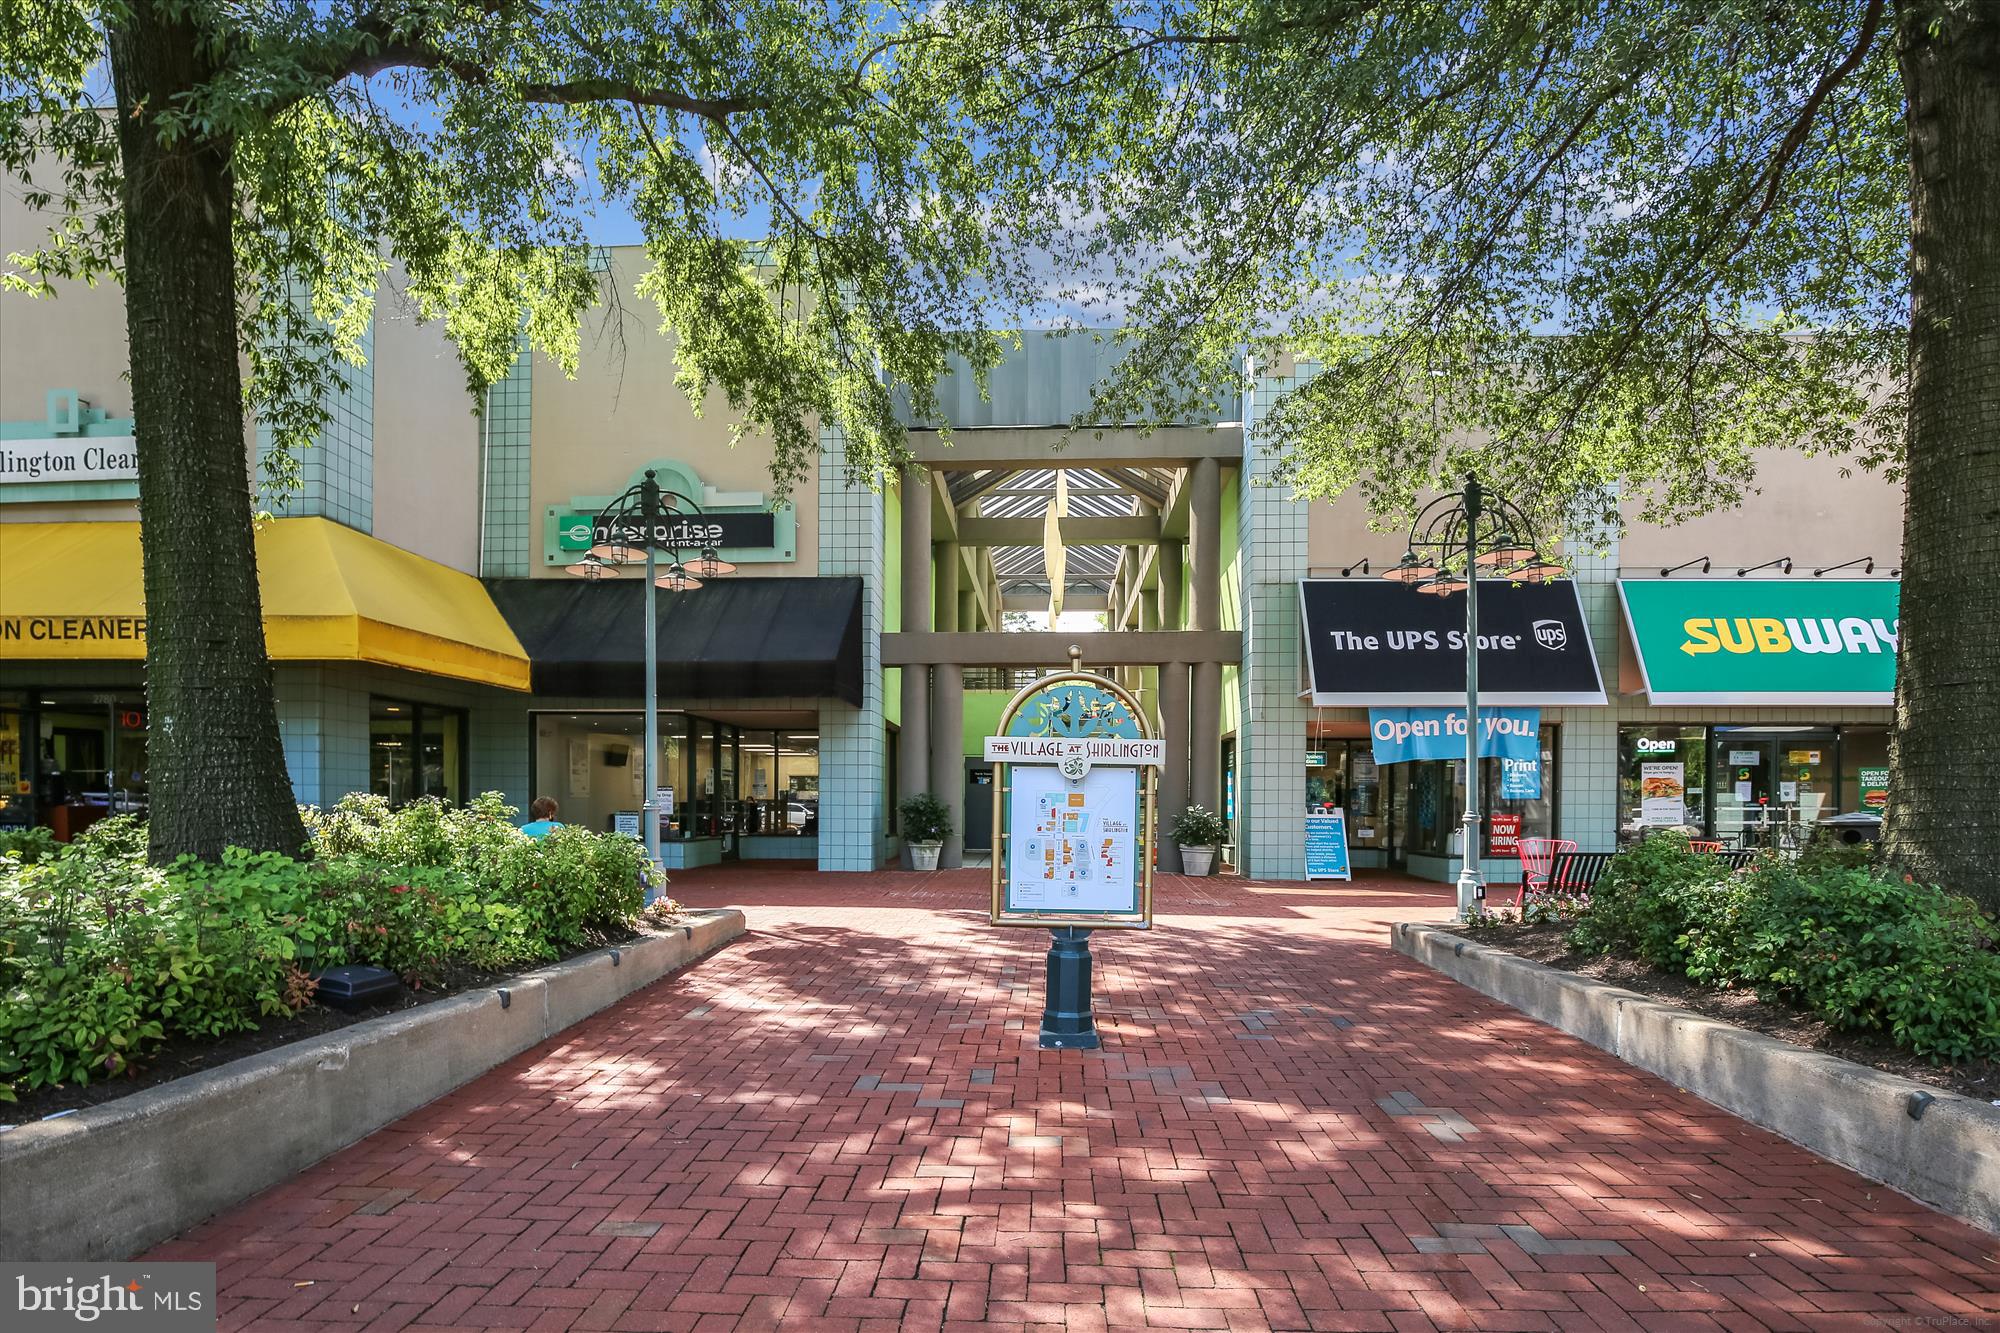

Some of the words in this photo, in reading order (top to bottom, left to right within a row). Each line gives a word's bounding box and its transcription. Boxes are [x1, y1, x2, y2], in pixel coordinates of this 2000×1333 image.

[0, 451, 76, 478] lington
[0, 620, 20, 640] N
[1536, 628, 1565, 646] ups
[1330, 631, 1379, 650] The
[1386, 631, 1440, 650] UPS
[1374, 719, 1440, 744] Open
[1485, 717, 1534, 740] you.
[991, 743, 1009, 752] THE
[1011, 741, 1063, 757] VILLAGE
[1068, 745, 1082, 753] AT
[1086, 741, 1159, 759] SHIRLINGTON
[1637, 737, 1676, 753] Open
[1504, 759, 1537, 772] Print
[1492, 825, 1516, 834] NOW
